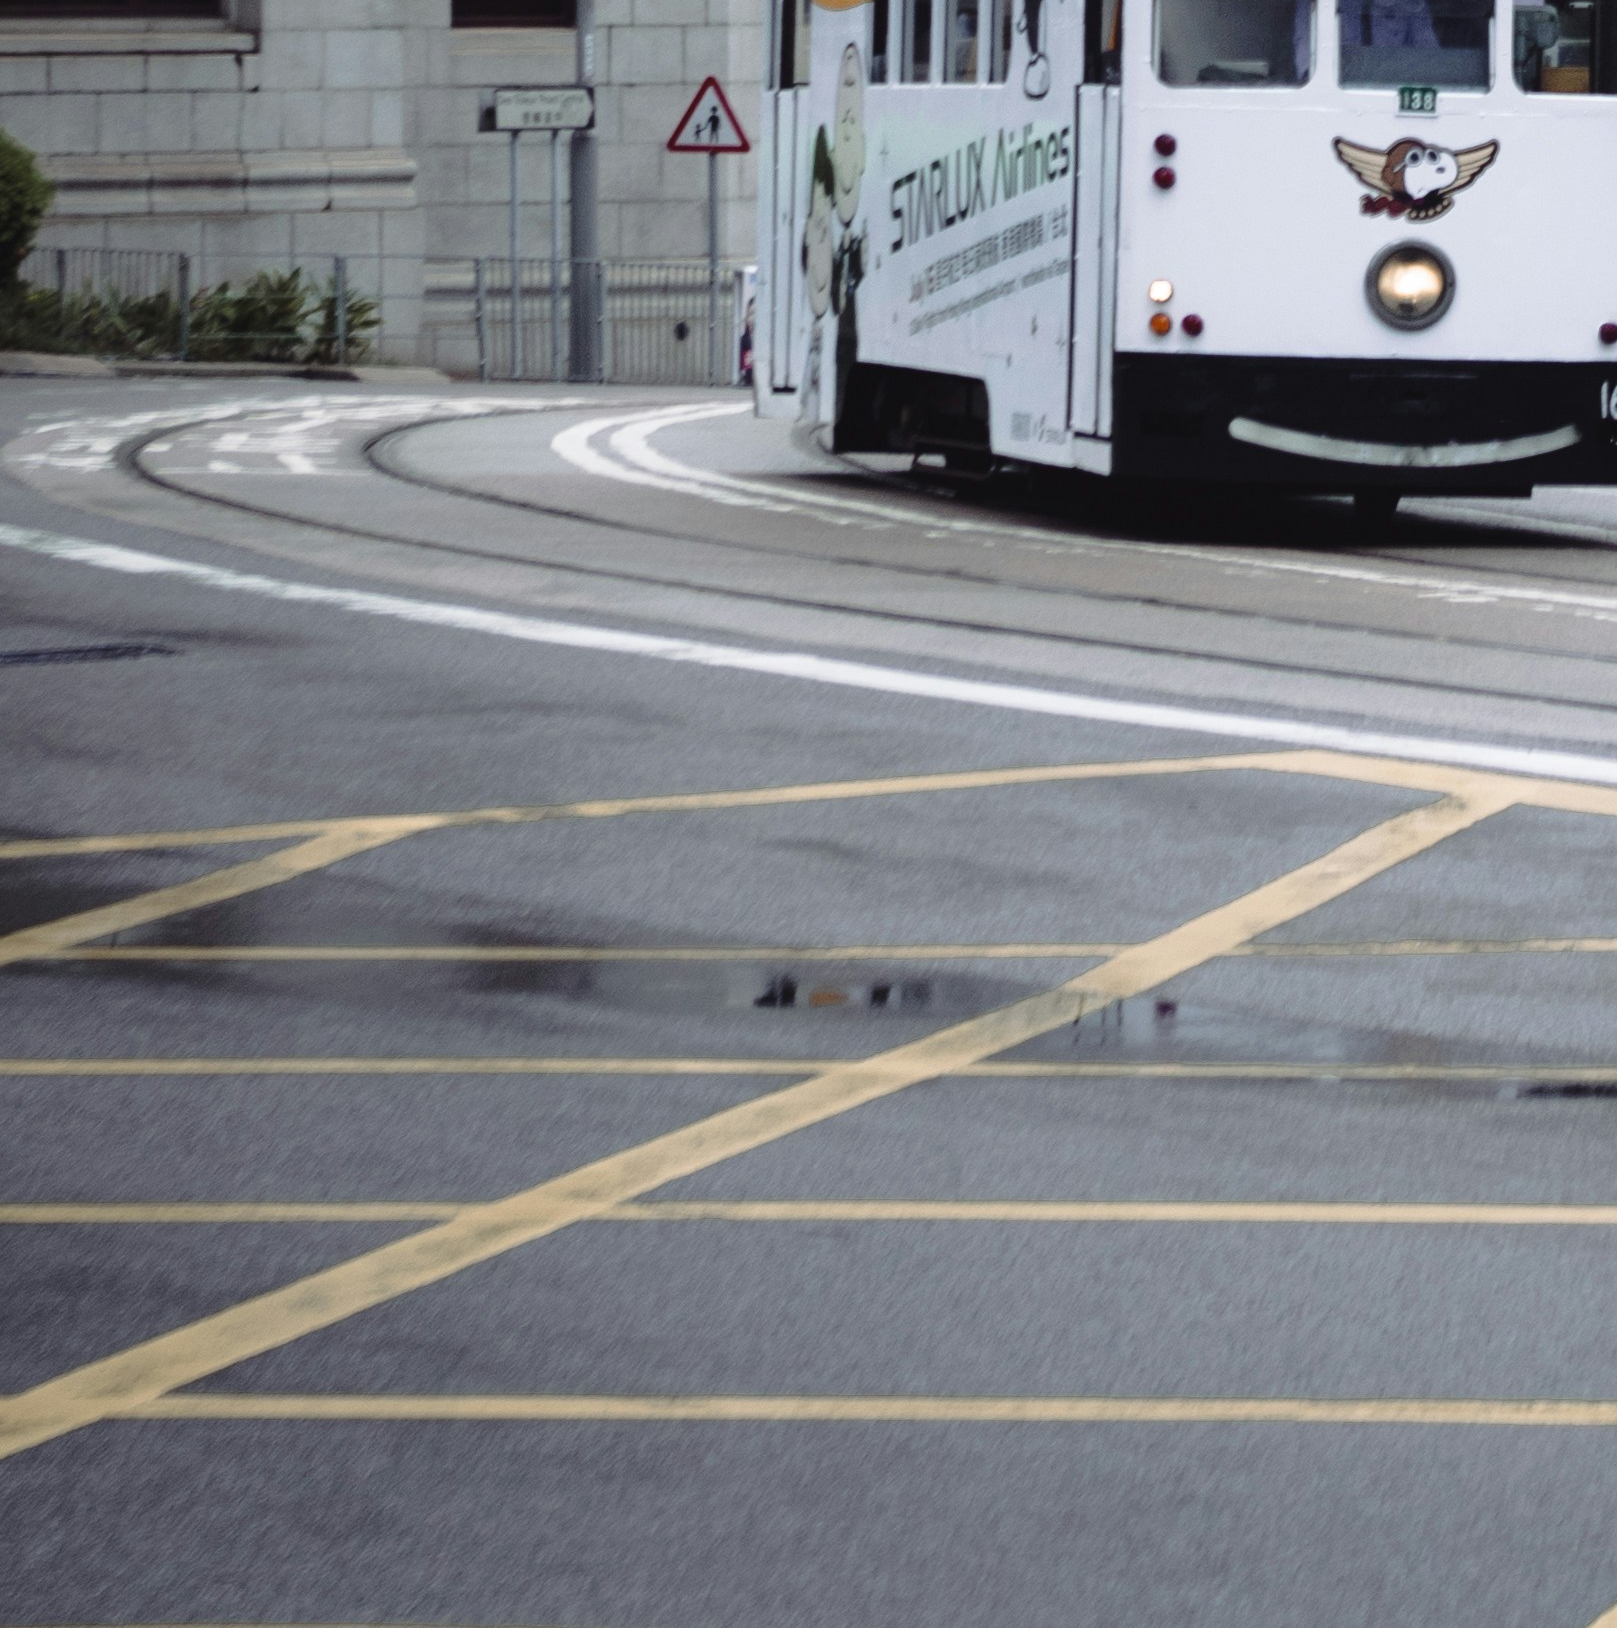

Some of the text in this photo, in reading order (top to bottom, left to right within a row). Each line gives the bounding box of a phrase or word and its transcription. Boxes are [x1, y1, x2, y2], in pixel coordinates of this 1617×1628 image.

[1403, 91, 1433, 110] 138
[891, 135, 986, 255] STARLUX
[991, 121, 1071, 209] Airlines
